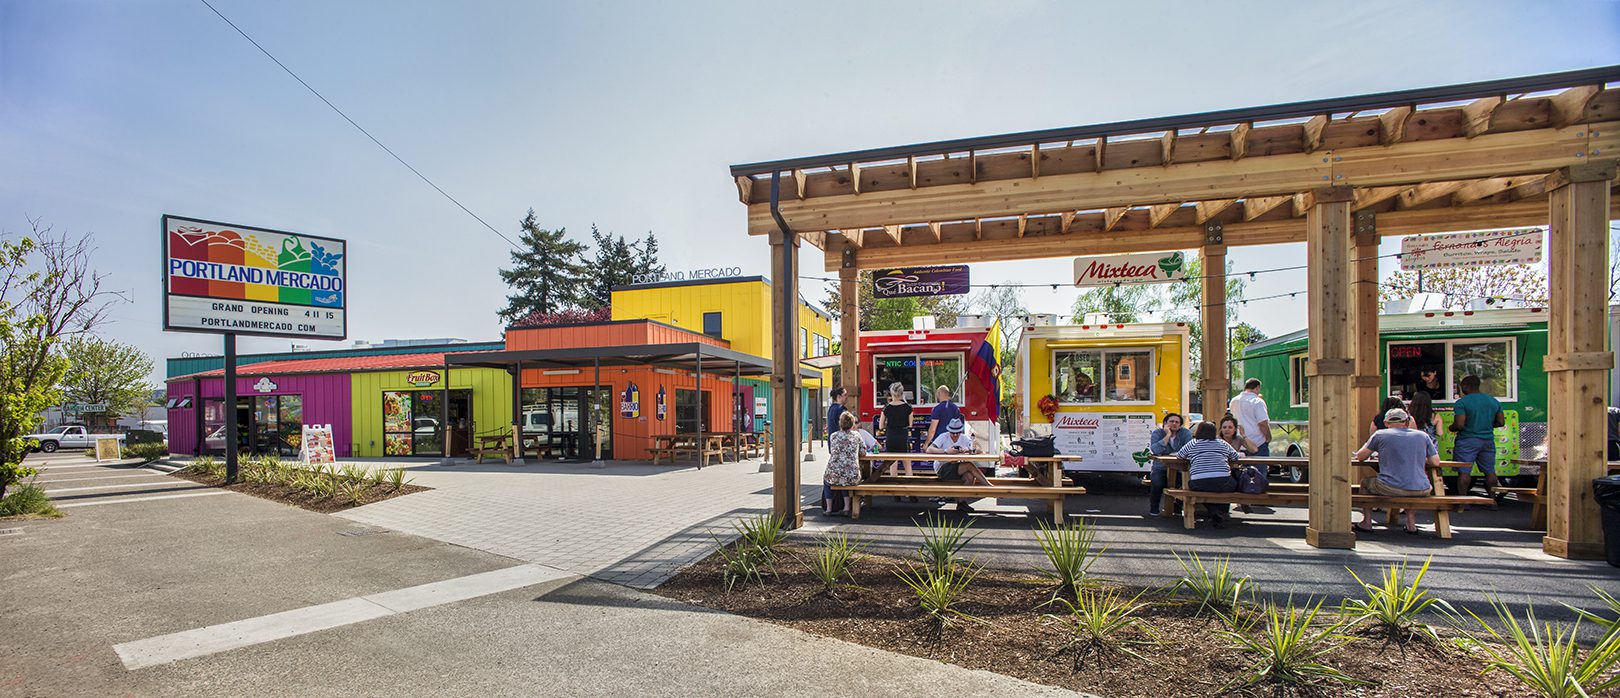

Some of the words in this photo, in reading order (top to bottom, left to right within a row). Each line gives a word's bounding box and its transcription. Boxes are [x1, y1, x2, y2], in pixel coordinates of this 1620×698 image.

[170, 259, 263, 284] PORTLAND
[266, 270, 343, 292] MERCADO
[689, 266, 742, 280] MERCADO
[1076, 260, 1158, 285] Mixteca
[212, 302, 244, 313] GRAND
[251, 305, 289, 316] OPENING
[201, 317, 293, 331] PORTLANDMERCADO
[298, 324, 316, 332] COM
[1391, 346, 1421, 358] OPEN
[903, 359, 945, 367] COLMBIAN
[1055, 415, 1099, 428] Mixteca
